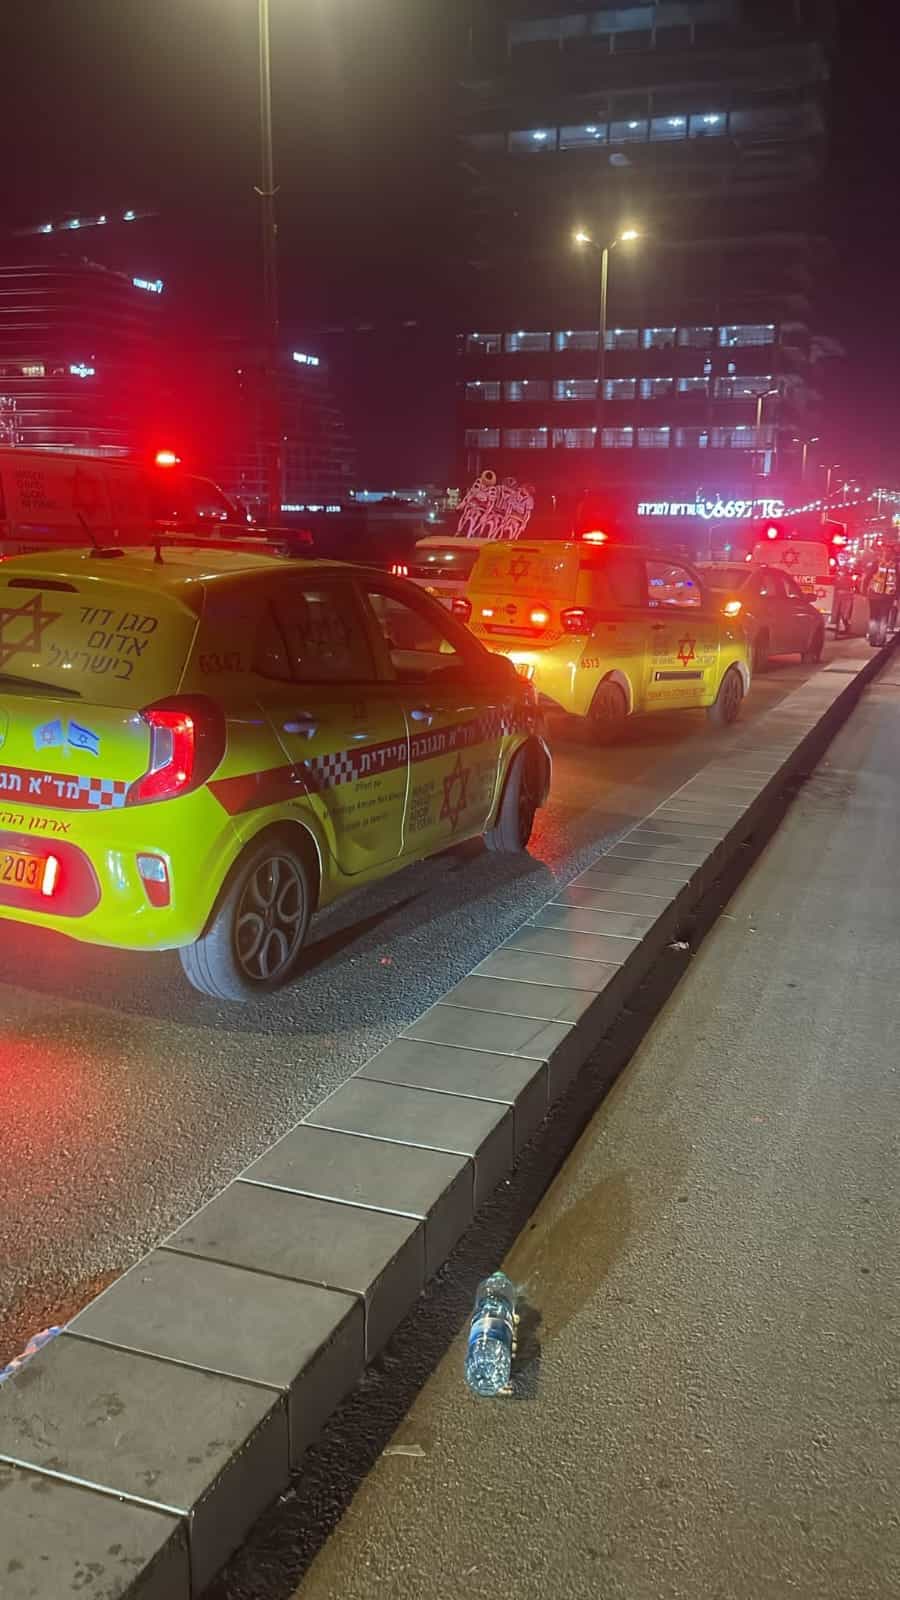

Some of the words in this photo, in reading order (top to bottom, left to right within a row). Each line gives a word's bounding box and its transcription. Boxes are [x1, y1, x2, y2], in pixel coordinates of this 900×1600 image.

[80, 606, 113, 625] דוד
[117, 612, 159, 634] מגן
[87, 630, 149, 657] אדום
[47, 641, 133, 681] בישראל
[359, 742, 408, 774] מיידית
[412, 734, 446, 758] תגובה
[28, 775, 80, 800] מד"א
[28, 815, 71, 833] ארגון
